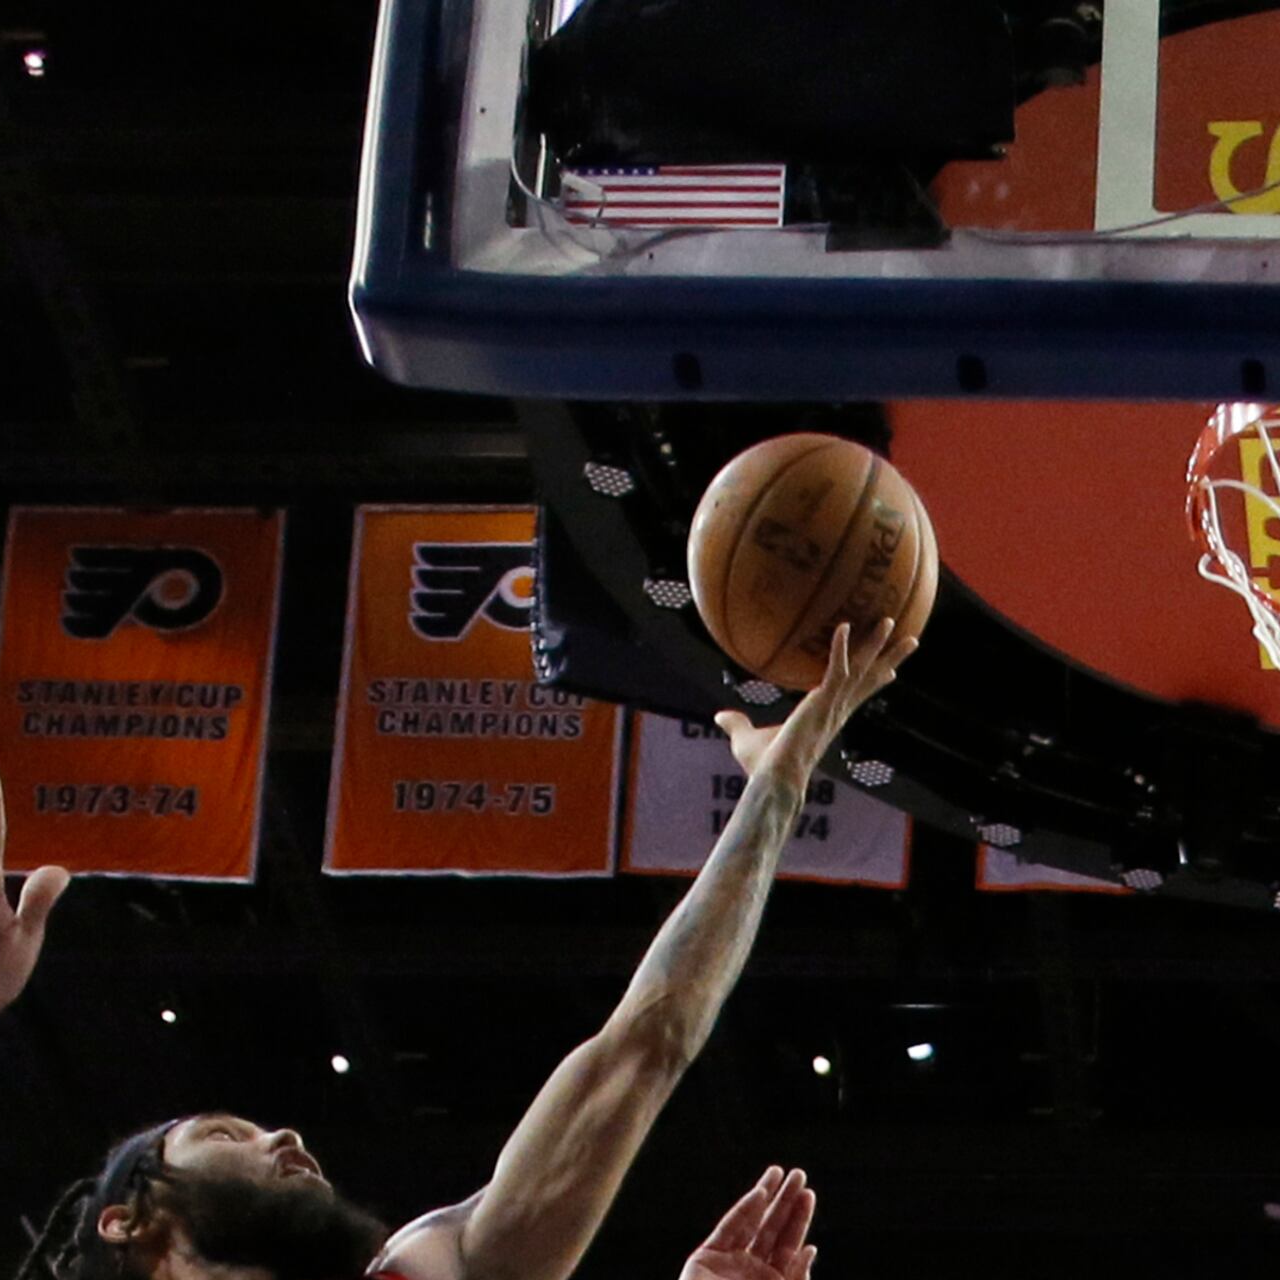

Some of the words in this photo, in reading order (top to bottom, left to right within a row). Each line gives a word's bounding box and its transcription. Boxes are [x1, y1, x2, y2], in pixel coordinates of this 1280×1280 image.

[17, 680, 167, 708] STANLEY
[176, 683, 244, 709] CUP
[370, 680, 520, 706] STANLEY
[23, 712, 231, 741] CHAMPIONS
[378, 710, 582, 738] CHAMPIONS
[35, 784, 199, 818] 1973-74
[394, 781, 556, 814] 1974-75
